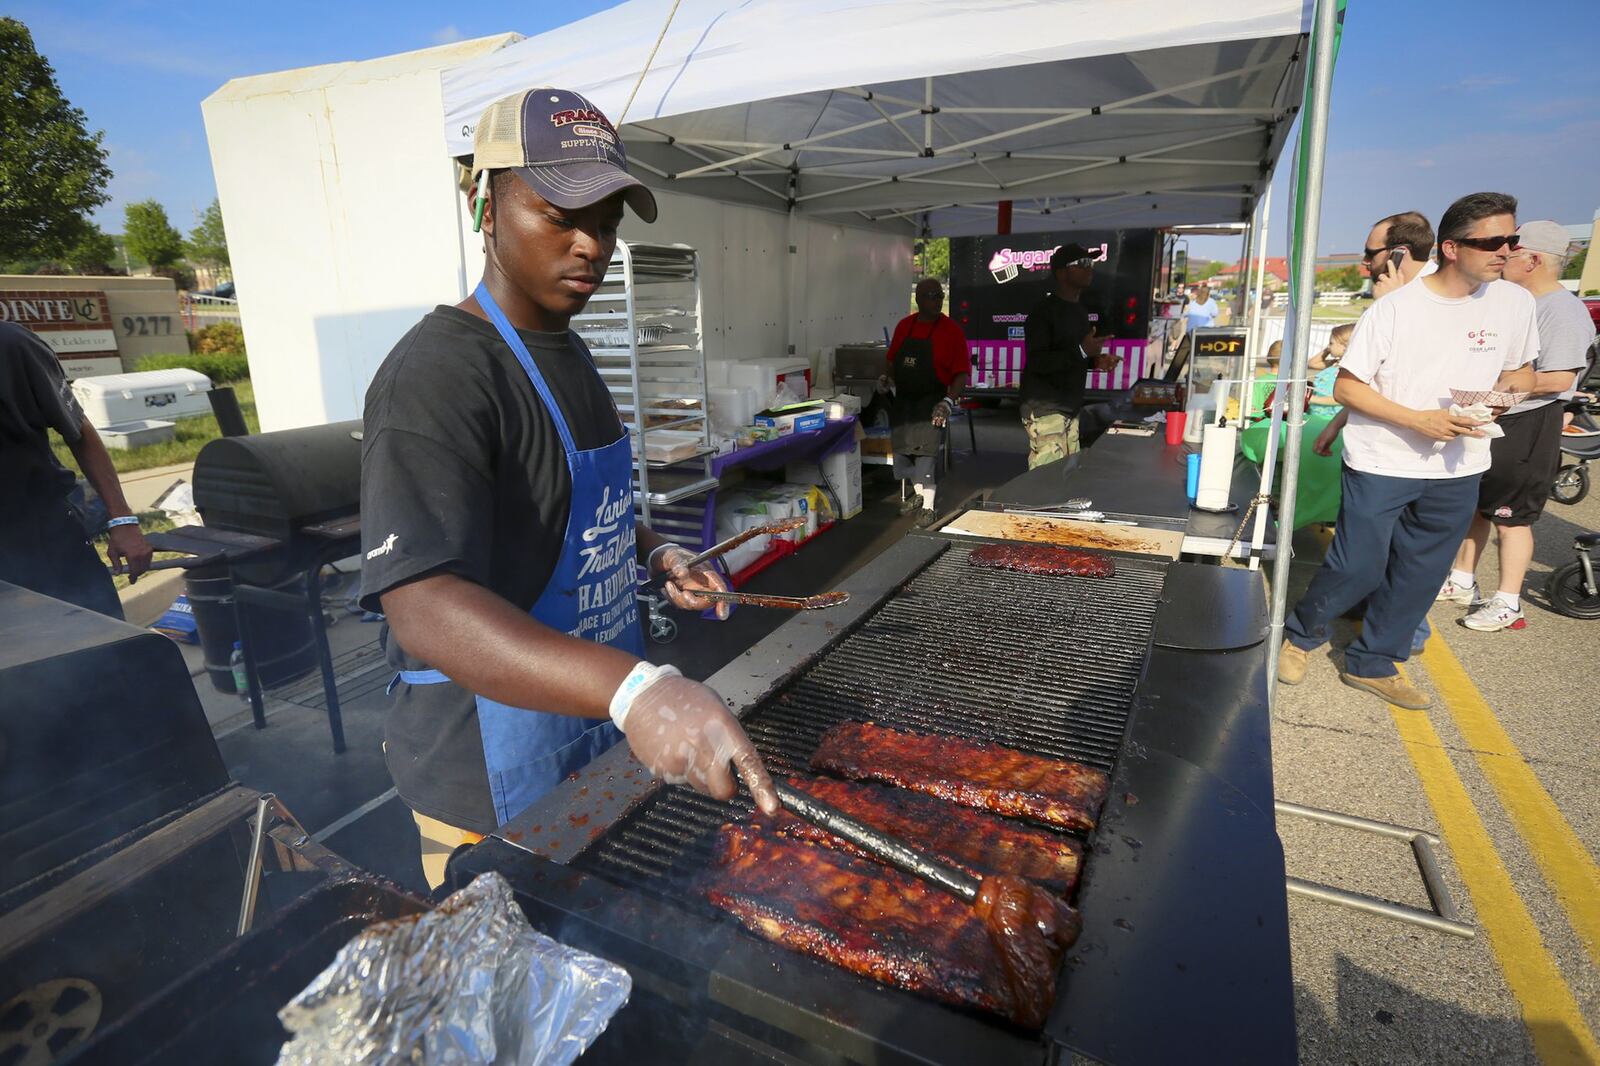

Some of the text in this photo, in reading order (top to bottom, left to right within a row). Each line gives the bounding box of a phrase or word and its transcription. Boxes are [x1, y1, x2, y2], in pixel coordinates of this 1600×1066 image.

[561, 139, 597, 149] SUPPLY
[0, 299, 74, 321] OINTE
[122, 316, 171, 336] 9277
[1200, 341, 1240, 352] HOT
[577, 543, 616, 580] True
[578, 556, 637, 613] HARDWAR
